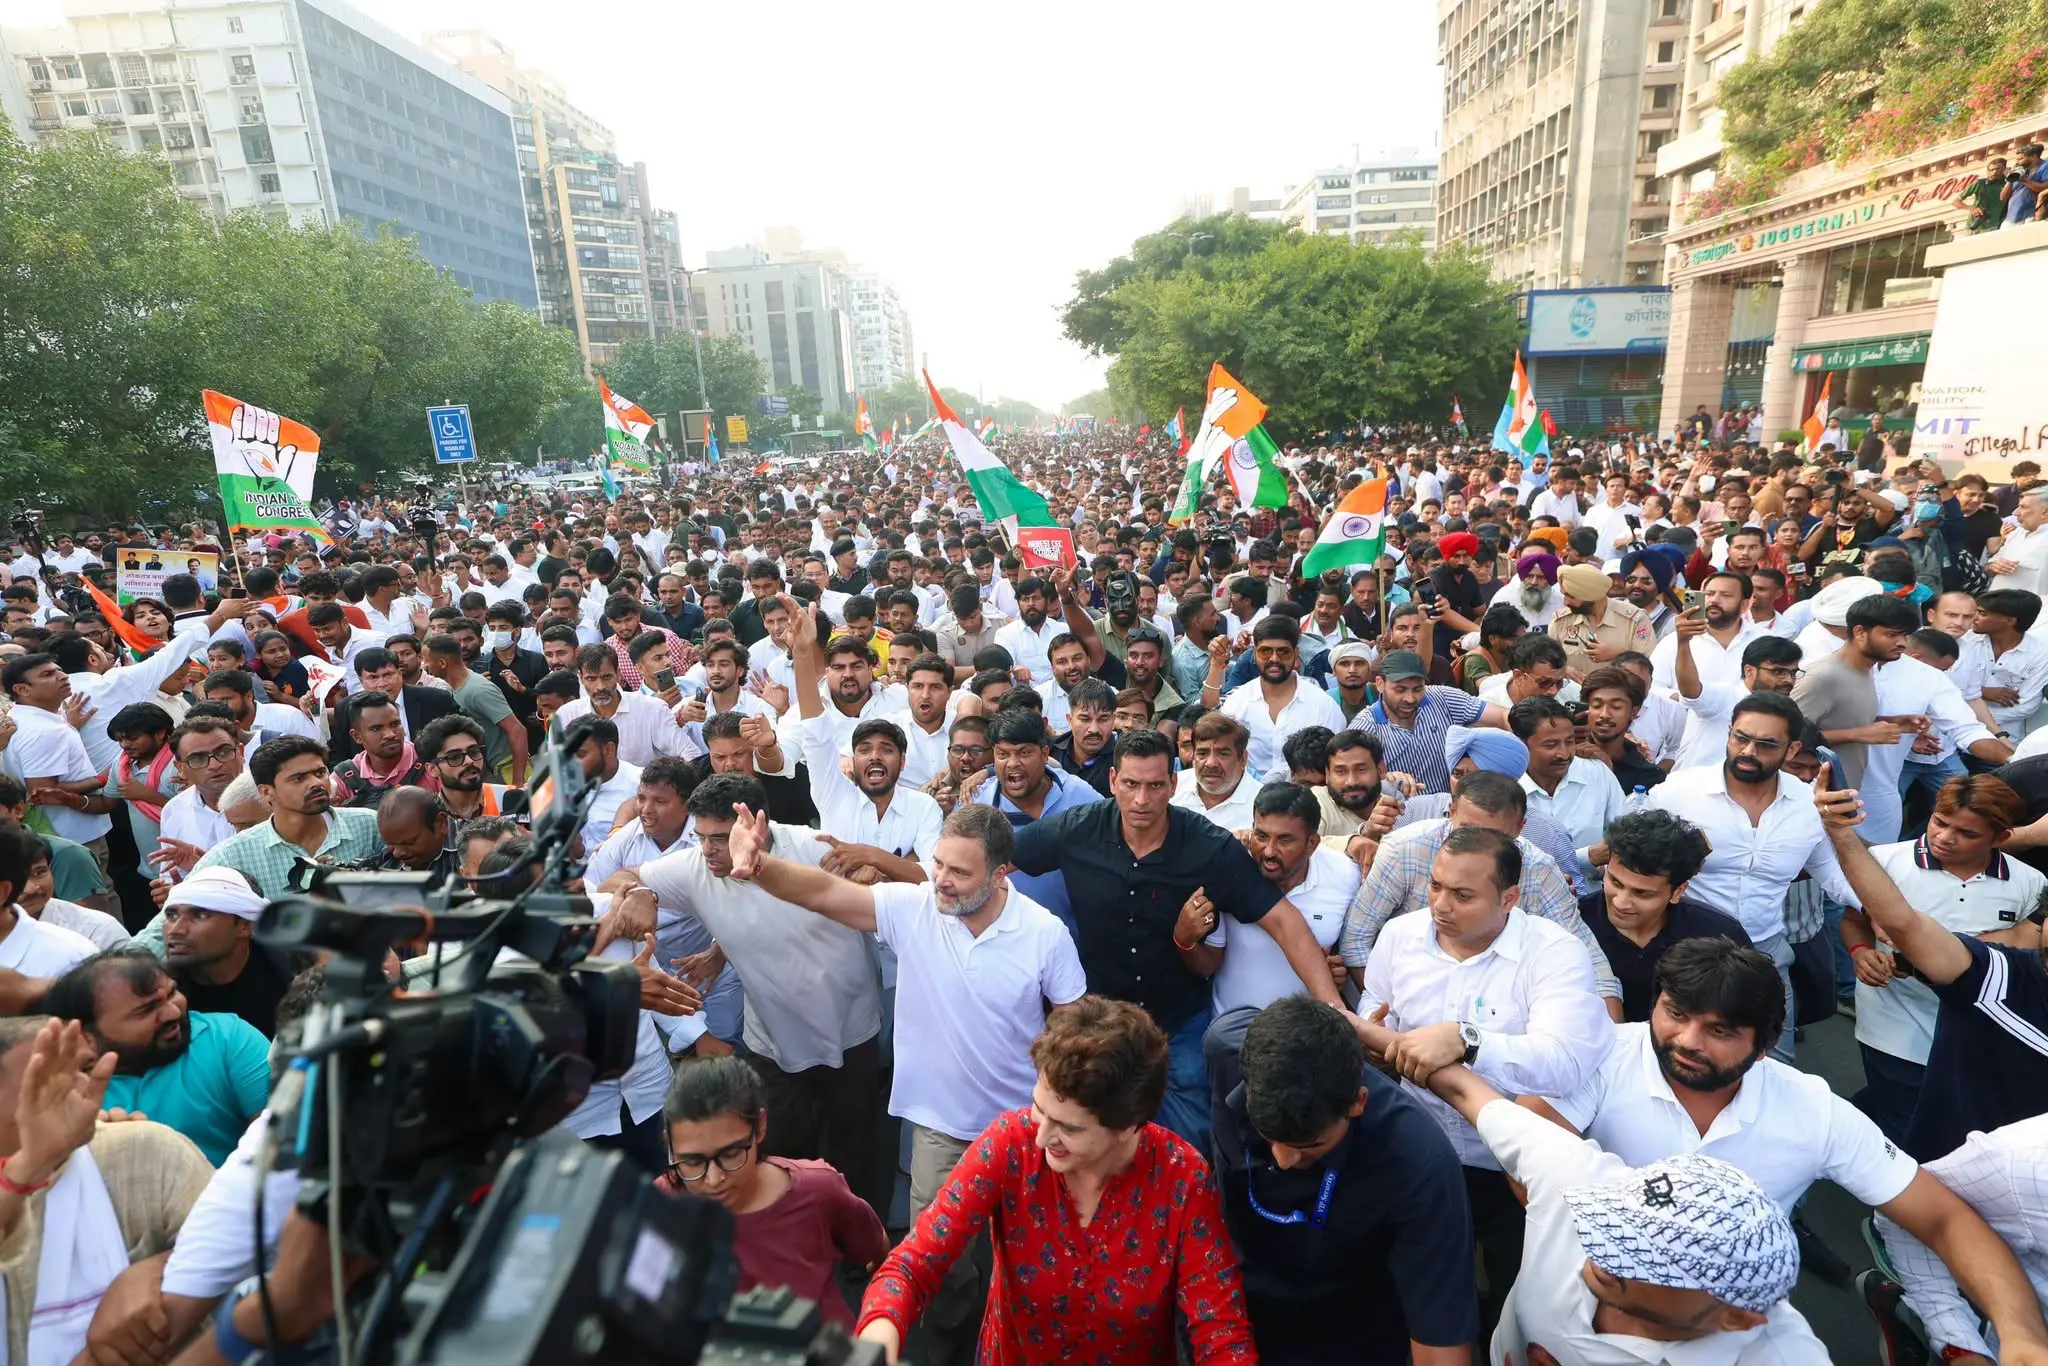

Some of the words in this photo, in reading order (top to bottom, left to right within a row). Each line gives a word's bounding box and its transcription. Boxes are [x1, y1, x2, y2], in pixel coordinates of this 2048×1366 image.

[1757, 200, 1890, 248] JUGGERNAUT
[244, 491, 288, 505] INDIAN
[1321, 1172, 1336, 1201] Security
[1317, 1200, 1326, 1213] VIP
